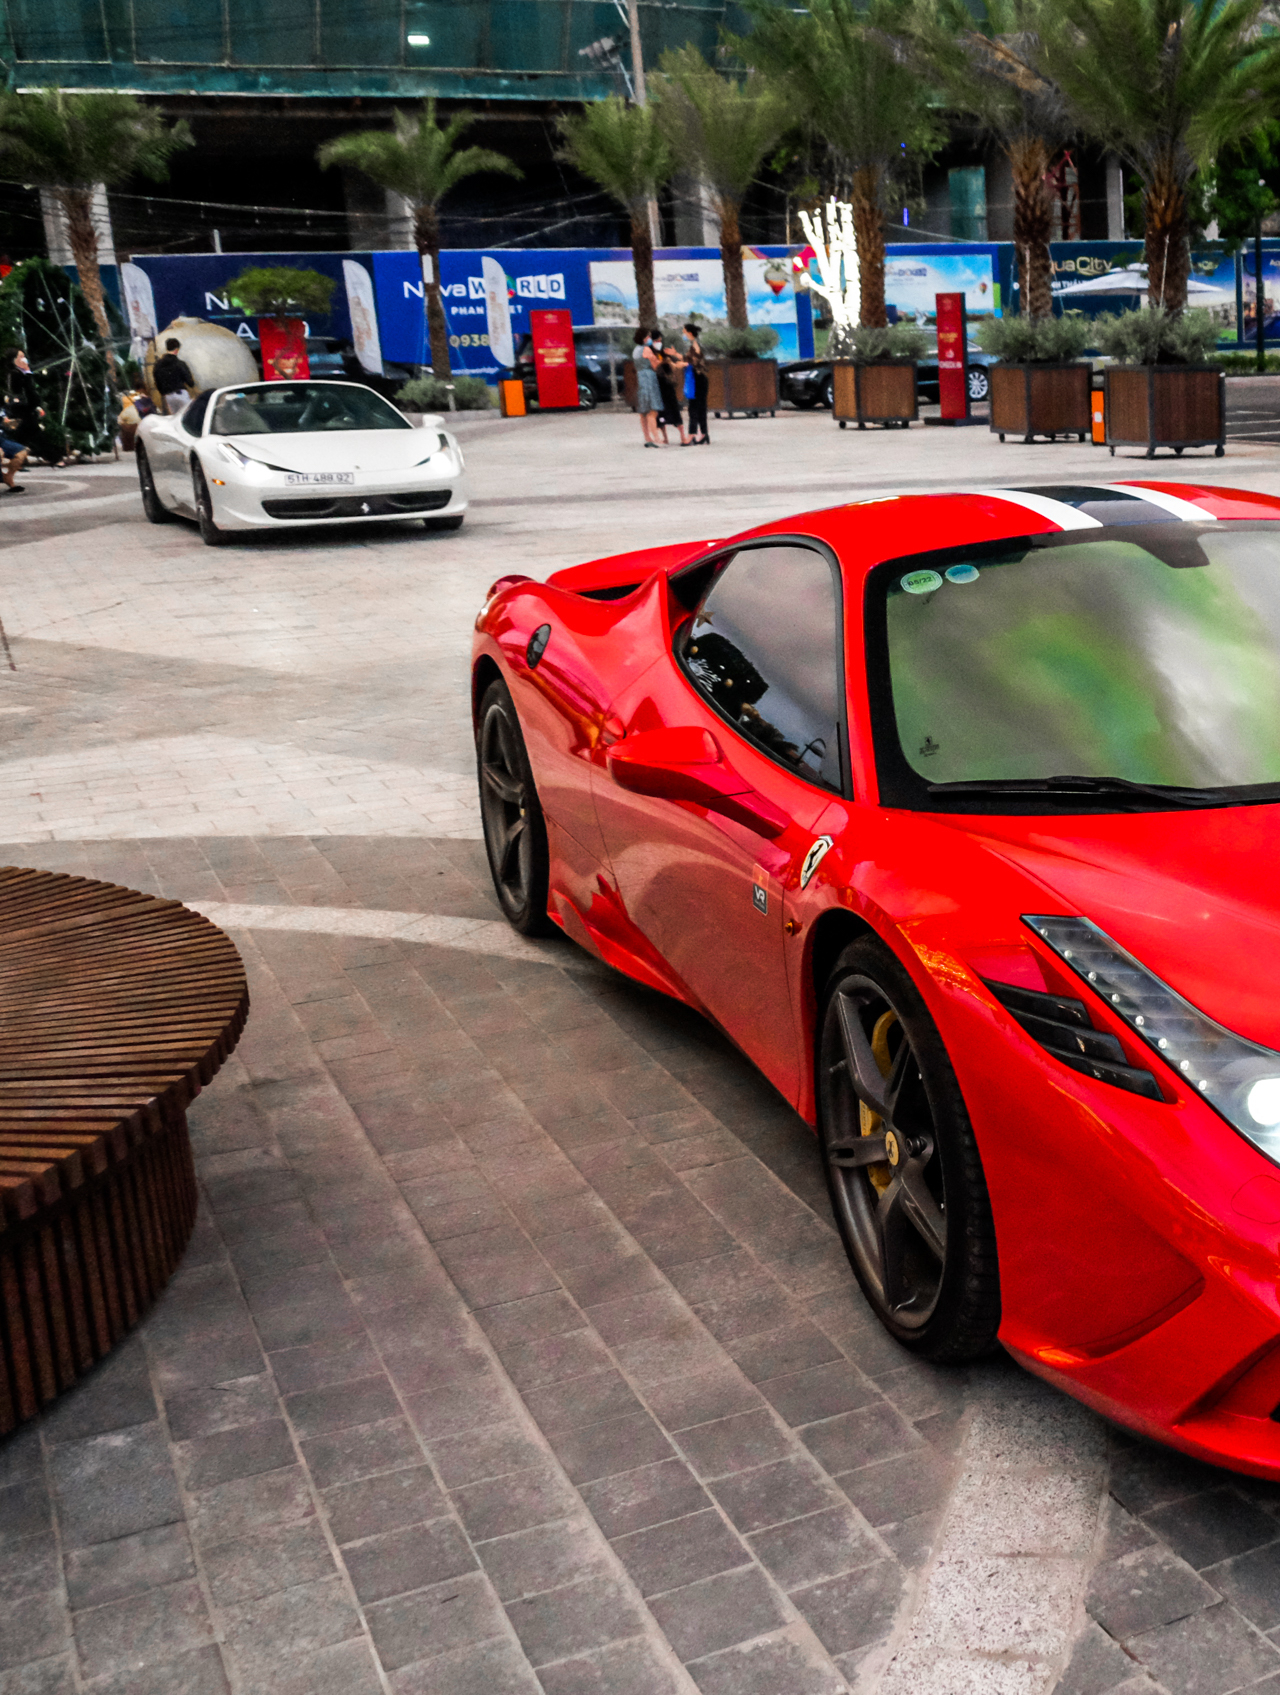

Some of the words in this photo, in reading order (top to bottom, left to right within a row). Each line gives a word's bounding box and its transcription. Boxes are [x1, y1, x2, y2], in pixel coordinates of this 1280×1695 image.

[1050, 256, 1113, 275] uaCity
[403, 273, 565, 299] NvaWRLD
[451, 306, 484, 315] PHAN
